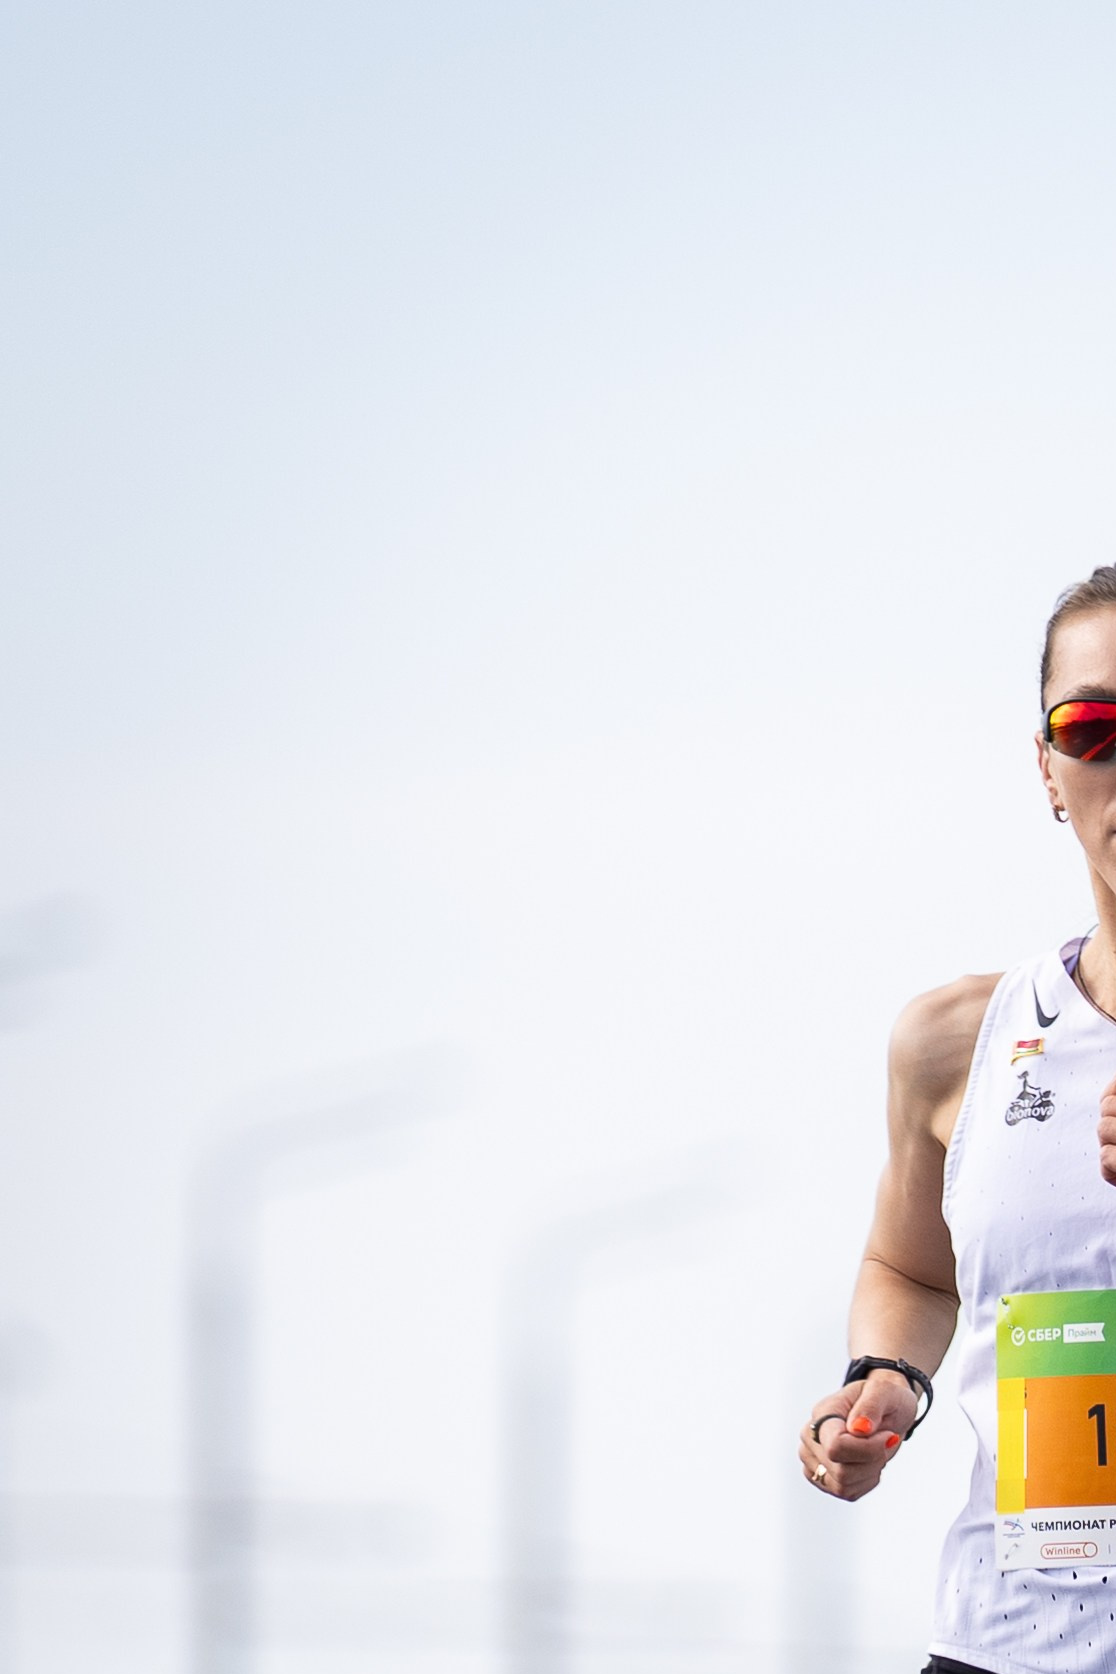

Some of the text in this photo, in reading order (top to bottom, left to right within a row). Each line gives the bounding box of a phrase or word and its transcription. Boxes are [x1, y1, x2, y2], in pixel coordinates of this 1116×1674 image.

[1027, 1327, 1097, 1342] СБЕР Прайм
[1031, 1519, 1106, 1532] ЧЕМПИОНАТ
[1044, 1545, 1081, 1556] Winline
